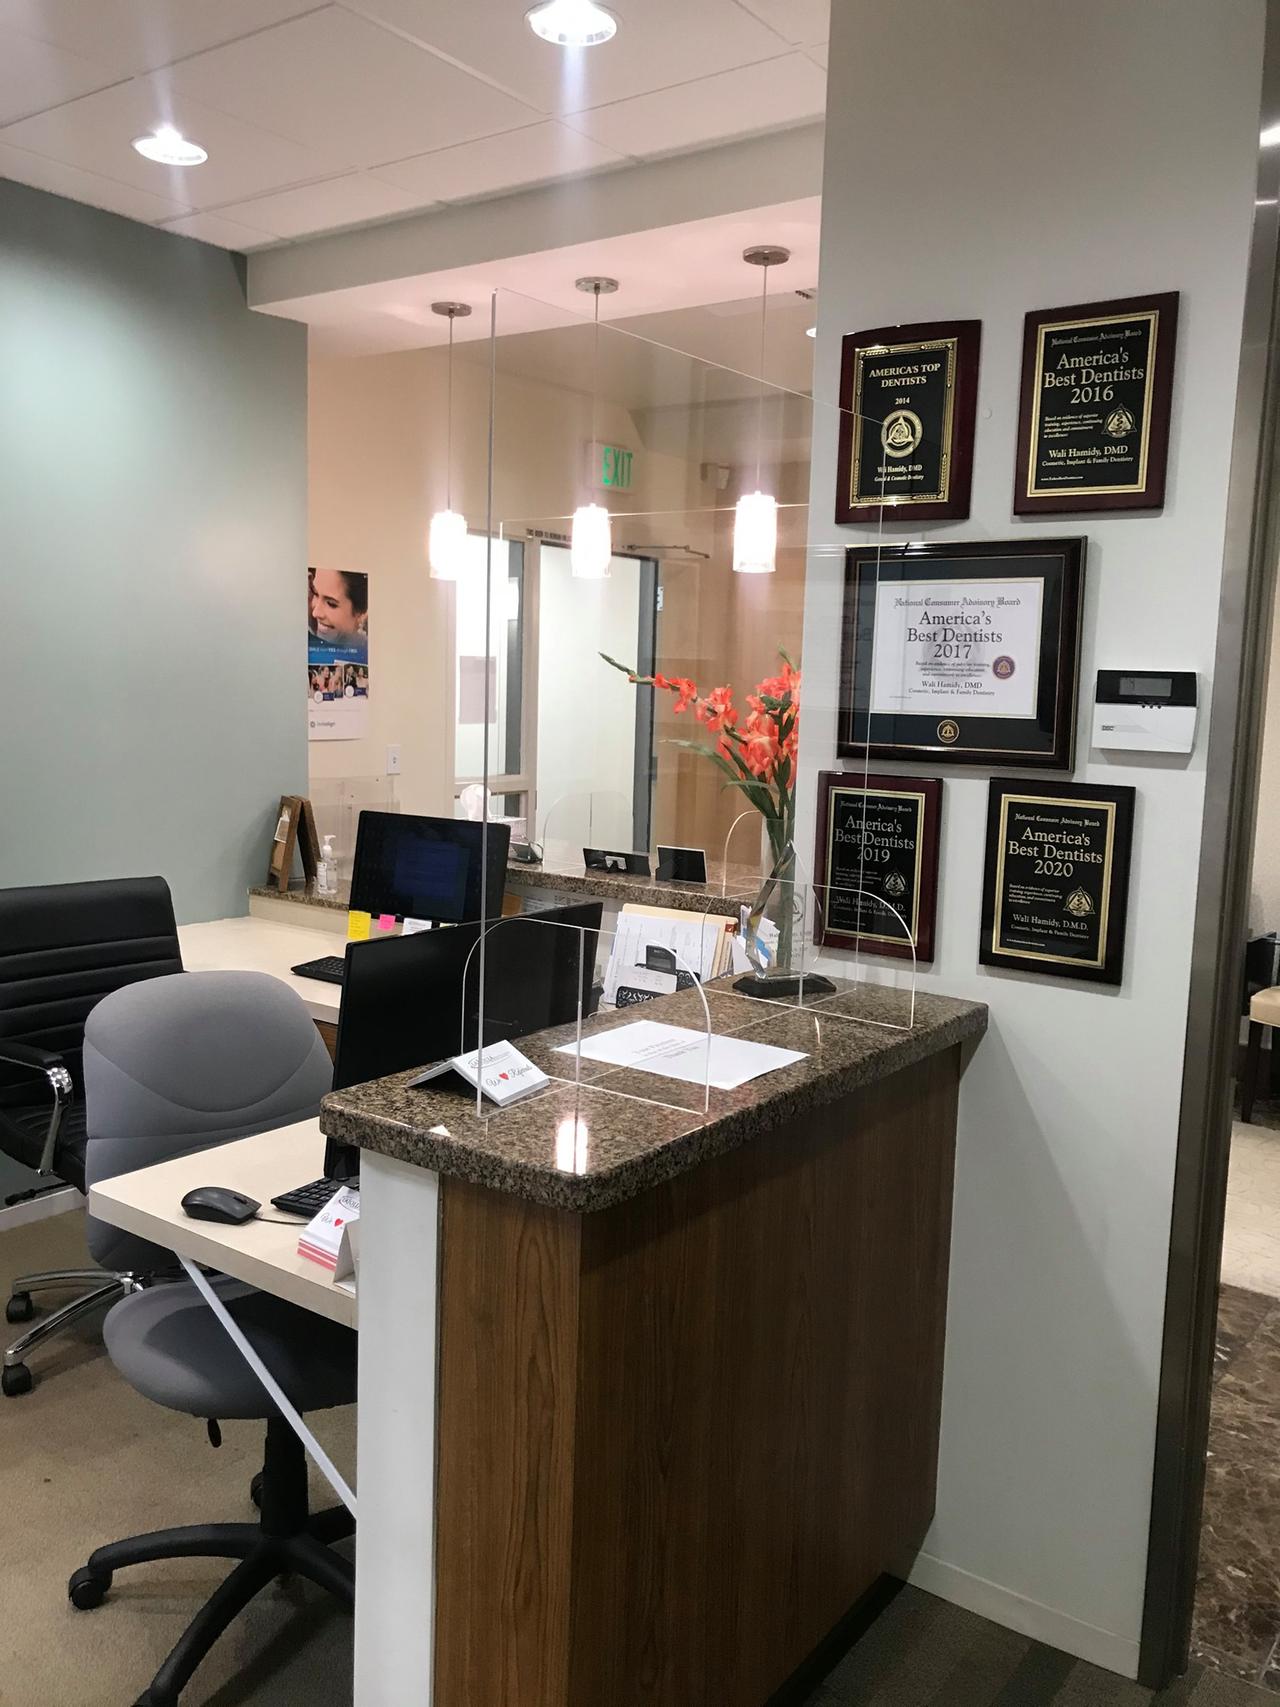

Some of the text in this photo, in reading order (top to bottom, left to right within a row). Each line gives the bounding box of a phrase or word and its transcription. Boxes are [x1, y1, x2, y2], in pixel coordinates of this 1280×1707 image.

[1056, 346, 1129, 370] America's
[869, 363, 941, 378] AMERICA'S TOP
[1044, 366, 1144, 388] Best Dentists
[881, 376, 927, 388] DENTISTS
[895, 397, 910, 405] 2014
[1070, 385, 1114, 404] 2016
[1049, 445, 1129, 458] Wali Hamidy, DMD
[602, 447, 633, 488] EXIT
[894, 597, 1021, 609] National Consumer Advisory Board
[919, 610, 992, 625] America's
[907, 628, 1003, 643] Best Dentists
[934, 644, 972, 659] 2017
[845, 816, 902, 833] America's
[834, 829, 915, 850] Best Dentists
[1021, 826, 1091, 846] America's
[857, 847, 891, 863] 2019
[1008, 840, 1103, 864] Best Dentists
[1034, 860, 1074, 878] 2020
[1013, 913, 1089, 931] Wali Hamidy, D.M.D.
